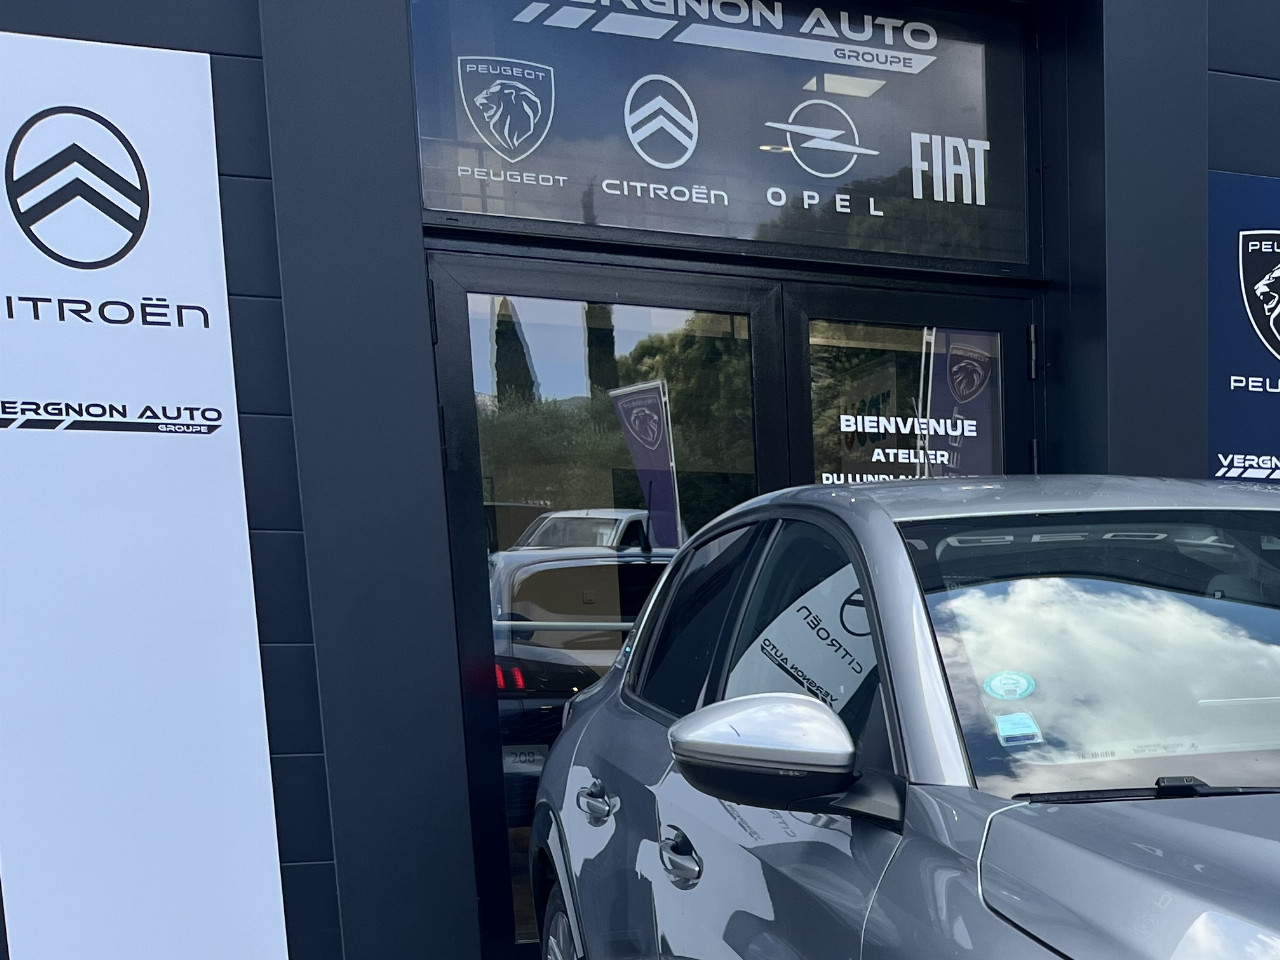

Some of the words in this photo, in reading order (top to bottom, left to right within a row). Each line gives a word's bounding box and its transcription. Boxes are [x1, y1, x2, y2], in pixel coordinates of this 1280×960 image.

[570, 0, 783, 29] GNON
[800, 7, 938, 50] AUTO
[834, 48, 913, 68] GROUPE
[466, 64, 546, 81] PEUGEOT
[458, 166, 568, 187] PEUGEOT
[911, 132, 990, 205] FIAT
[602, 179, 729, 206] CITROËN
[766, 187, 884, 216] OPEL
[6, 296, 210, 329] ITROËN
[0, 400, 127, 419] ERGNON
[137, 404, 222, 421] AUTO
[158, 424, 208, 433] GROUPE
[839, 415, 977, 437] BIENVENUE
[871, 448, 949, 464] ATELIER
[822, 473, 844, 485] DU
[510, 752, 536, 764] 208
